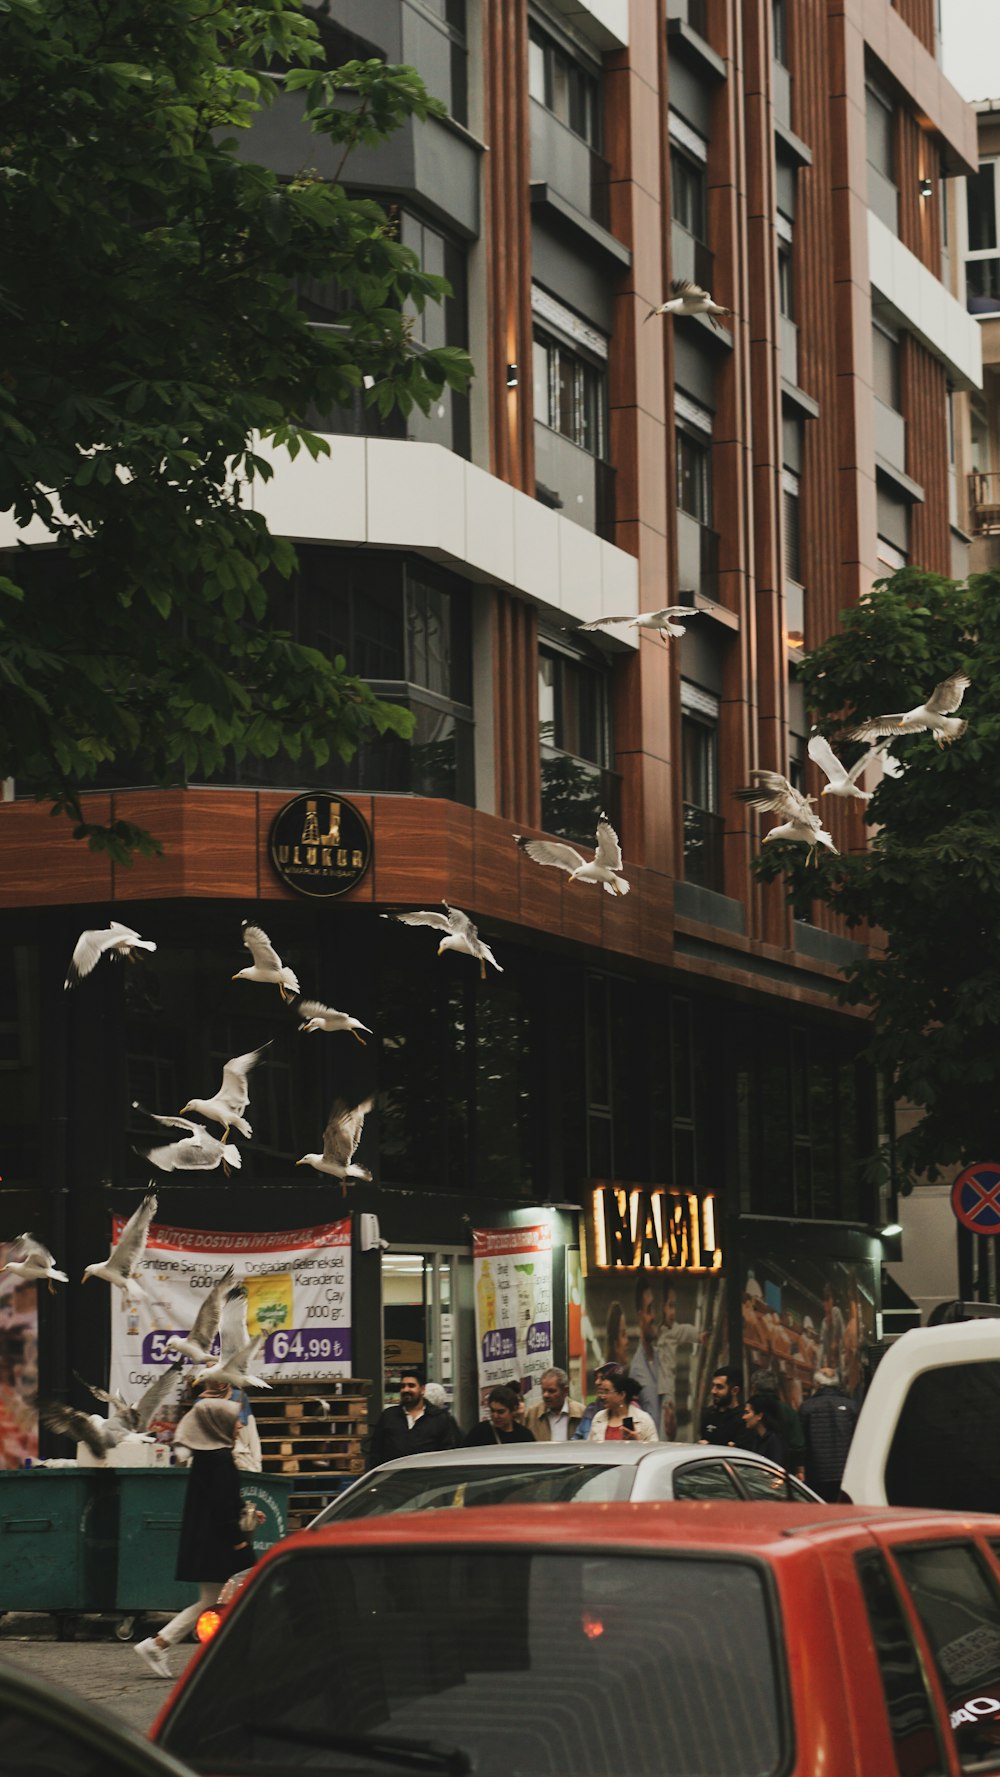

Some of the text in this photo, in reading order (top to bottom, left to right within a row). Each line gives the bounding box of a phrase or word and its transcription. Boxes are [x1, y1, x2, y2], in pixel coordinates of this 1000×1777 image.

[278, 845, 364, 869] ULUKUR
[156, 1228, 193, 1250] BÜTÇE
[194, 1235, 234, 1248] DOSTU
[234, 1237, 249, 1248] EN
[245, 1256, 345, 1276] Doğadan Geleneksel
[294, 1272, 344, 1287] Karadeniz
[325, 1288, 345, 1304] Çay
[272, 1331, 331, 1360] 64,99
